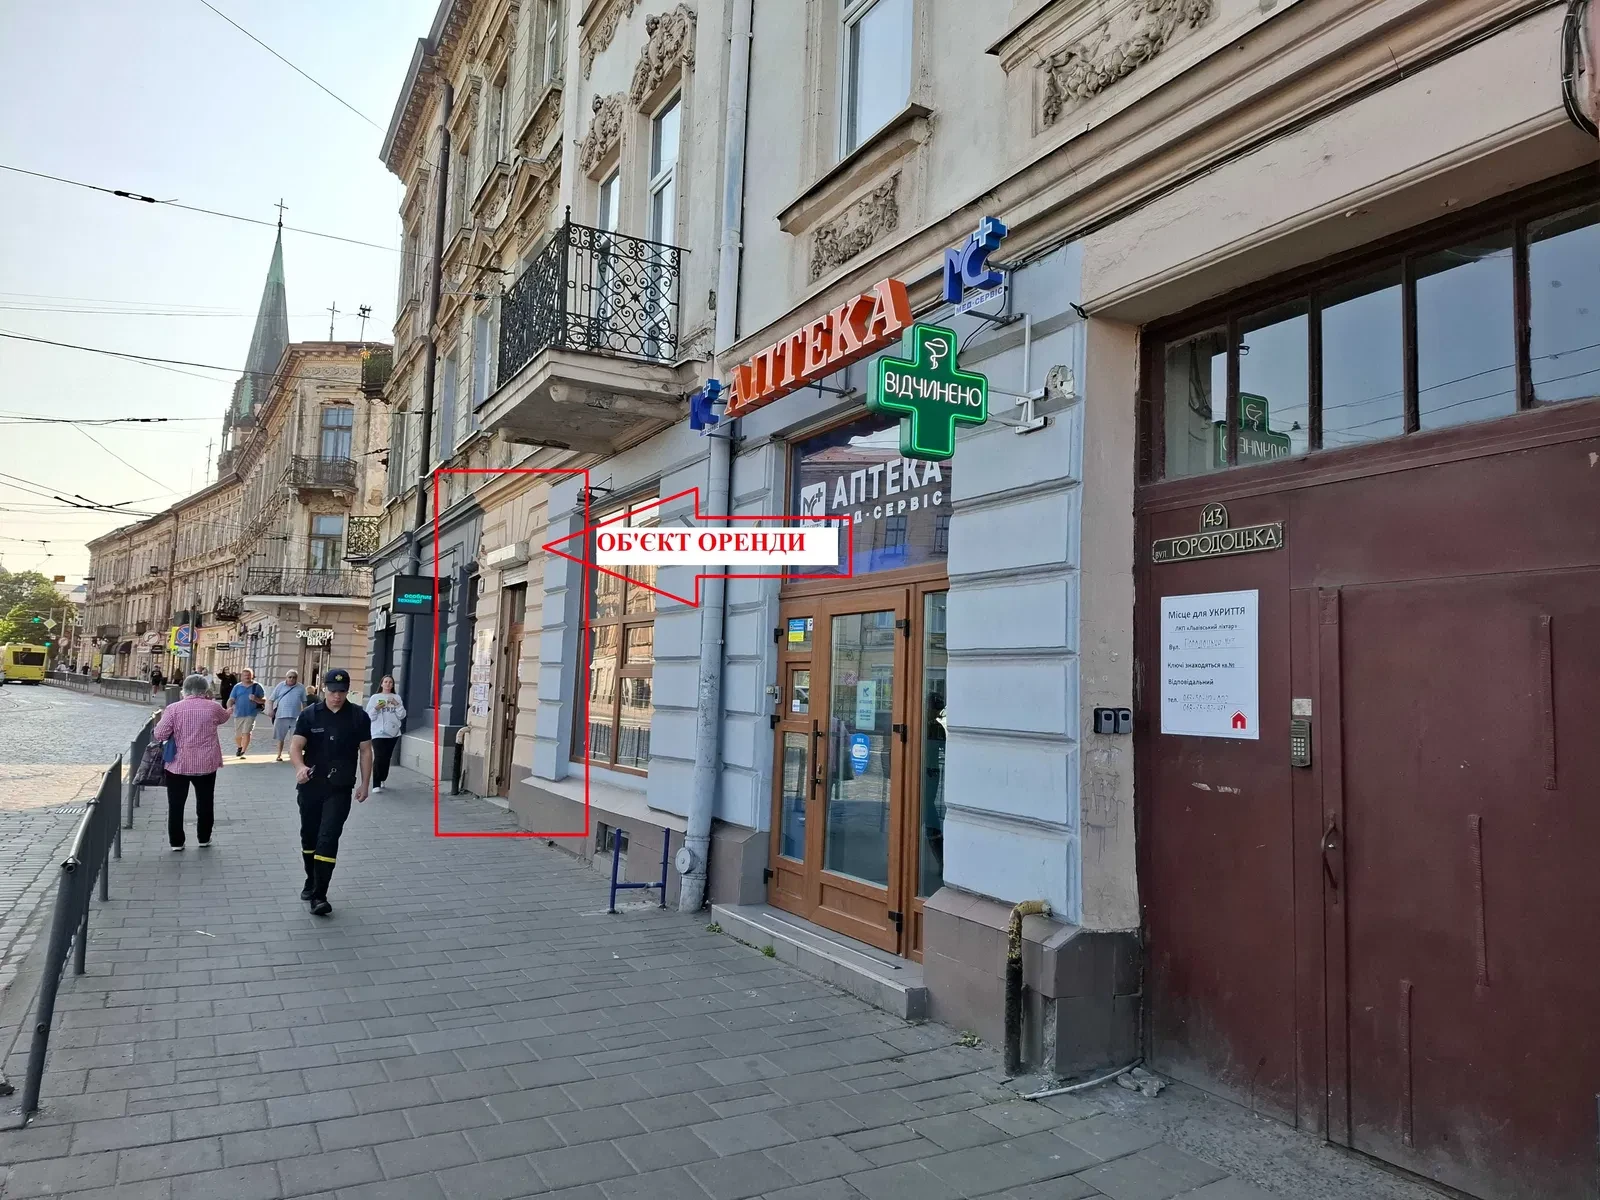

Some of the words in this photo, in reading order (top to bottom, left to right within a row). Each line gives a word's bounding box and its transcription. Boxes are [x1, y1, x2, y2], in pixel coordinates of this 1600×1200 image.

[724, 278, 908, 416] АПТЕКА
[884, 371, 983, 408] ВІДЧИНЕНО
[832, 458, 943, 510] АПТЕКА
[1202, 508, 1223, 528] 143
[1172, 528, 1277, 557] ГОРОДОЦЬКА
[1168, 611, 1191, 619] Місце
[1192, 610, 1208, 619] для
[1208, 606, 1246, 617] УКРИТТЯ
[1168, 678, 1214, 686] Відповідальний
